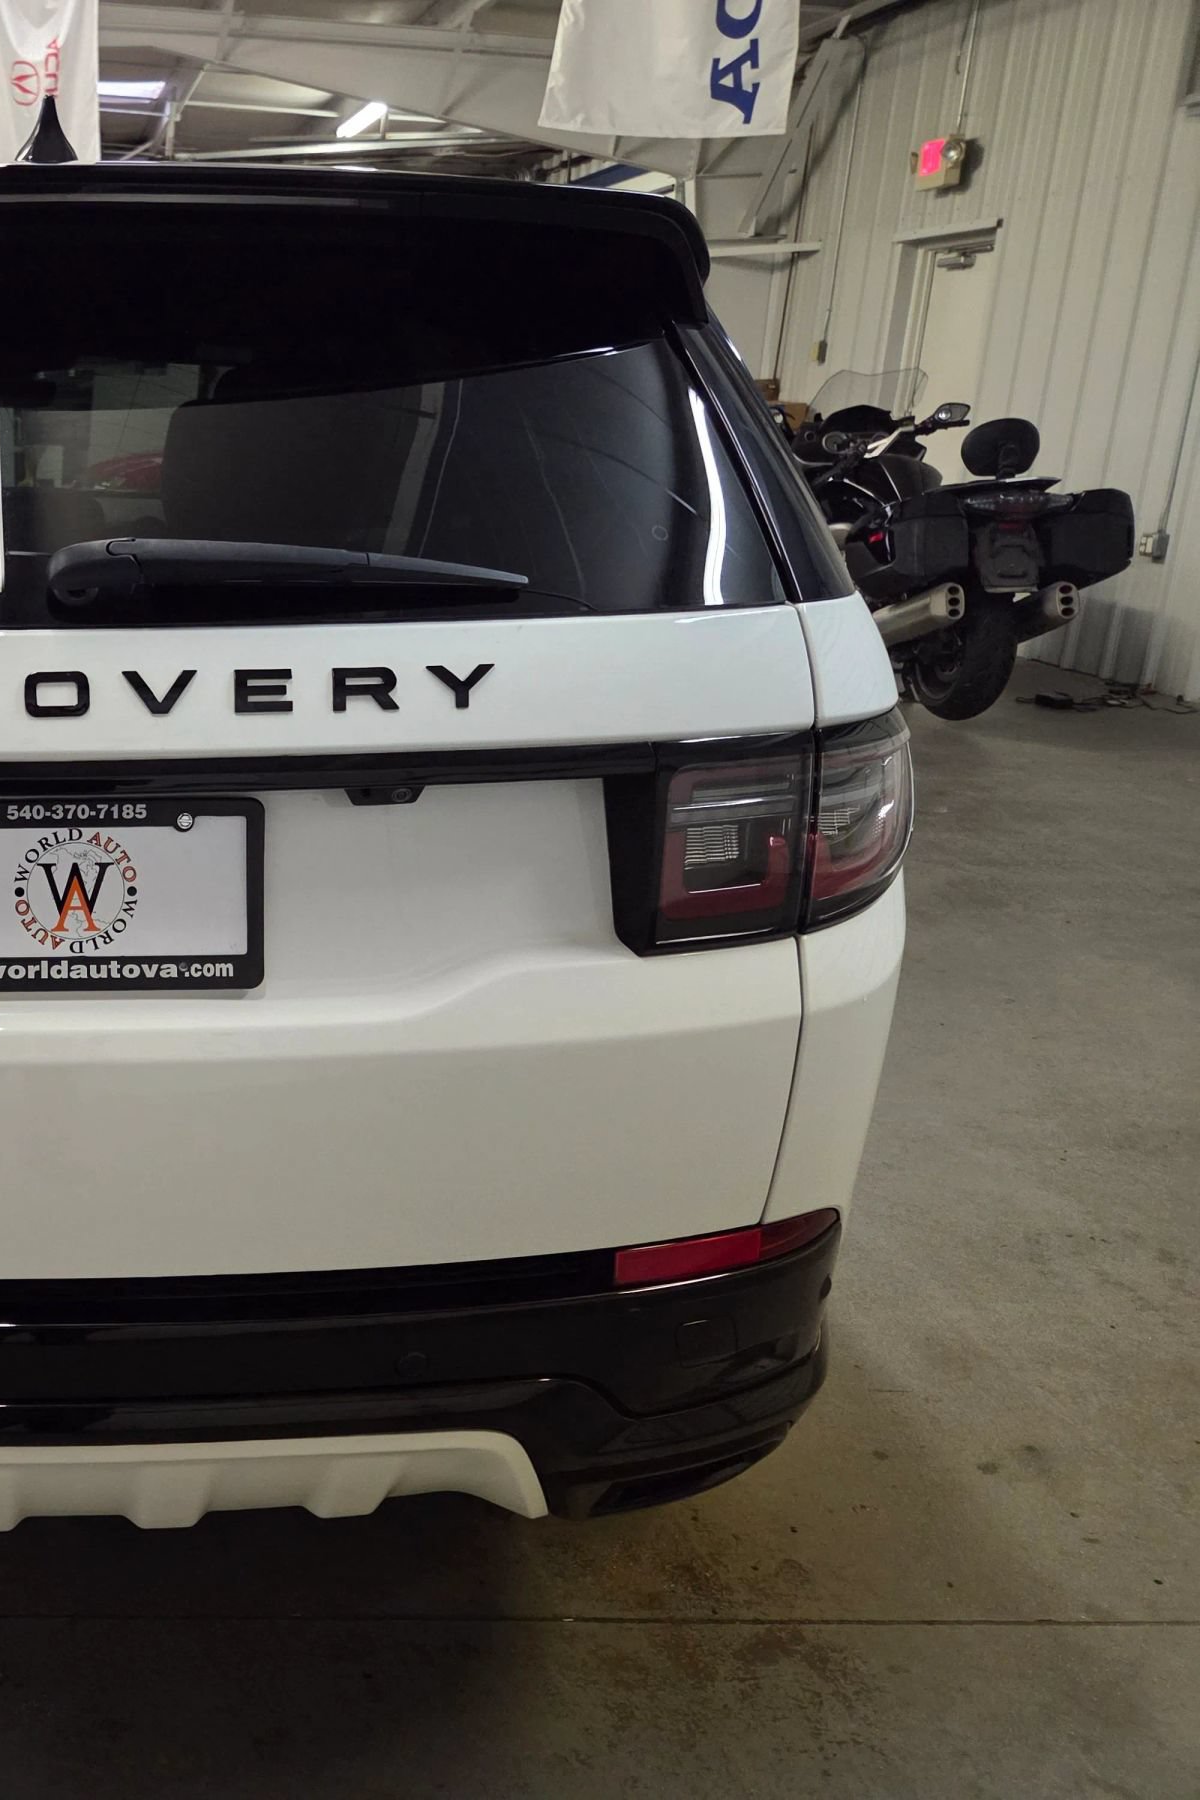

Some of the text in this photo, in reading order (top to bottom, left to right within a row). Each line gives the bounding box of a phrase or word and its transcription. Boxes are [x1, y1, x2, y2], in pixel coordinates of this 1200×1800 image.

[6, 803, 148, 820] 540-370-7185
[13, 827, 137, 883] WORLD AUTO
[14, 898, 138, 954] WORLD AUTO
